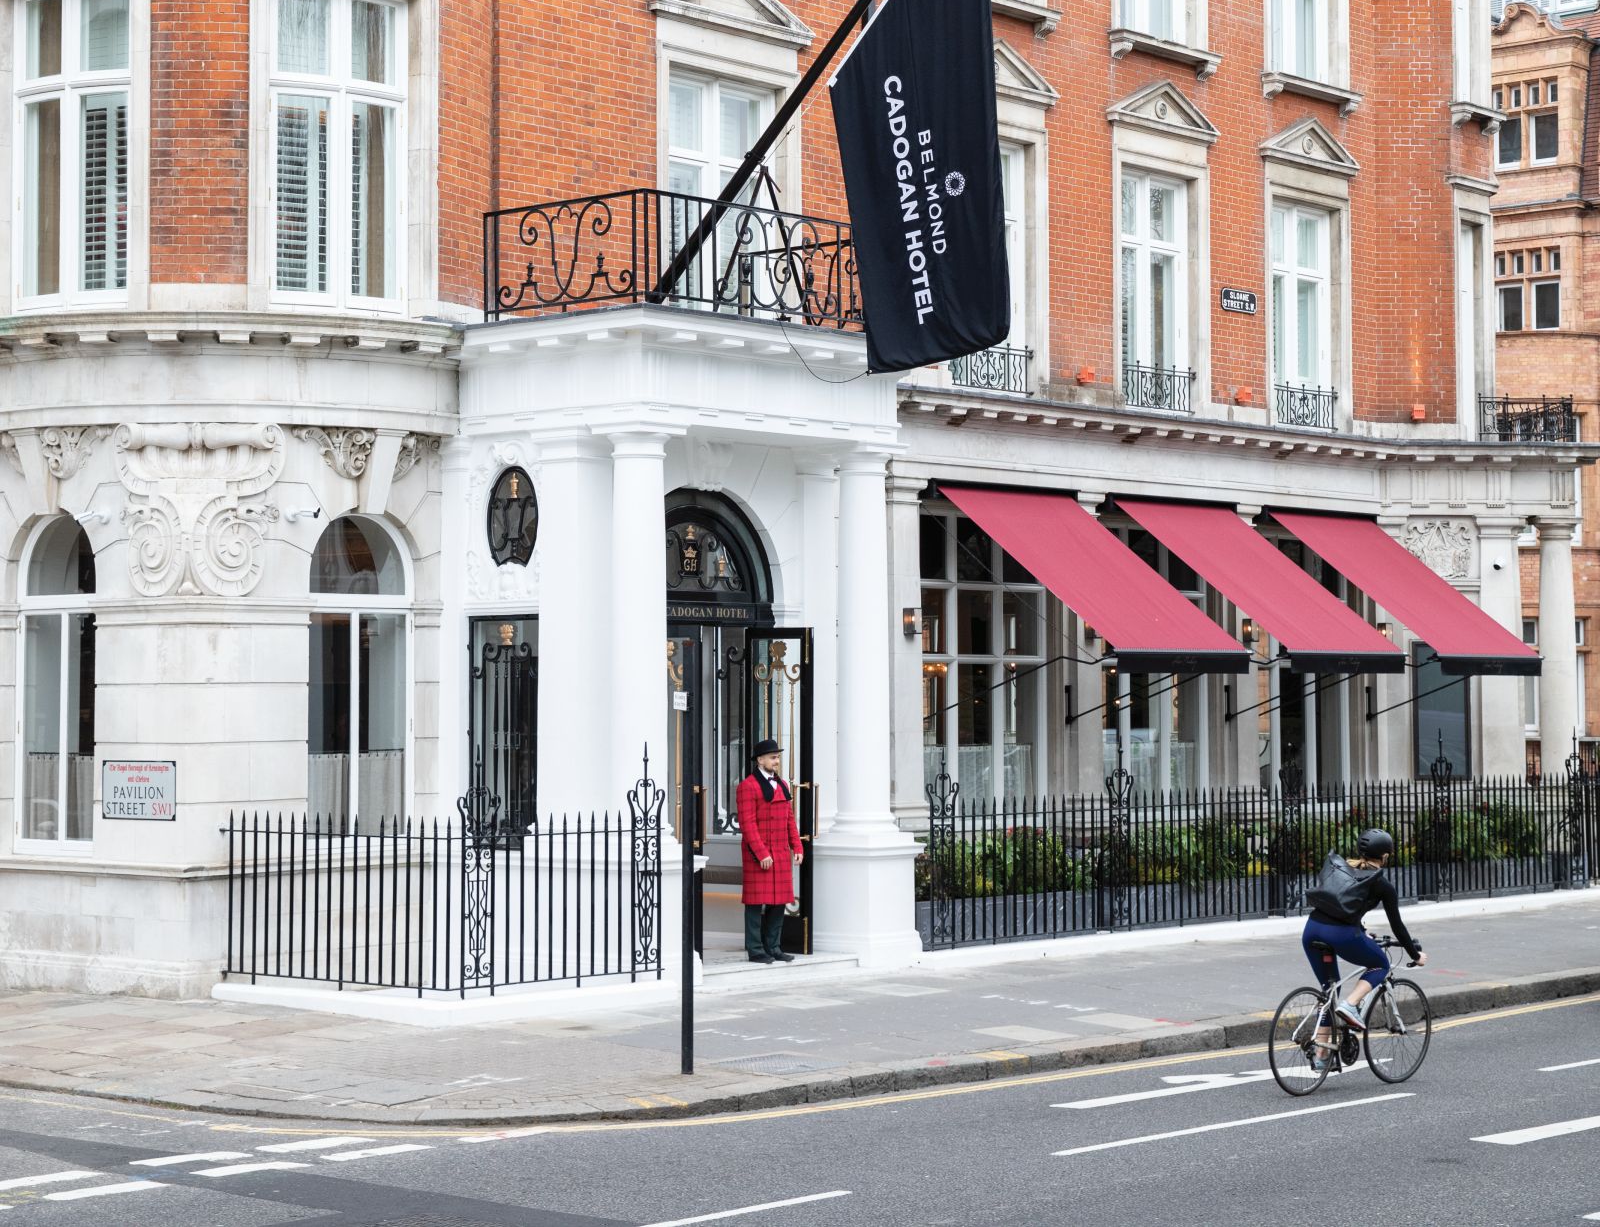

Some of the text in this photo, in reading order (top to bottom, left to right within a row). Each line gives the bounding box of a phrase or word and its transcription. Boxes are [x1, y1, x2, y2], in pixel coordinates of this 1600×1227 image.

[918, 129, 947, 255] BELMOND
[884, 75, 934, 325] CADOGAN HOTEL
[1229, 291, 1250, 302] SLOANE
[1223, 299, 1243, 309] STREET
[716, 607, 749, 619] HOTEL
[113, 786, 164, 799] PAVILION
